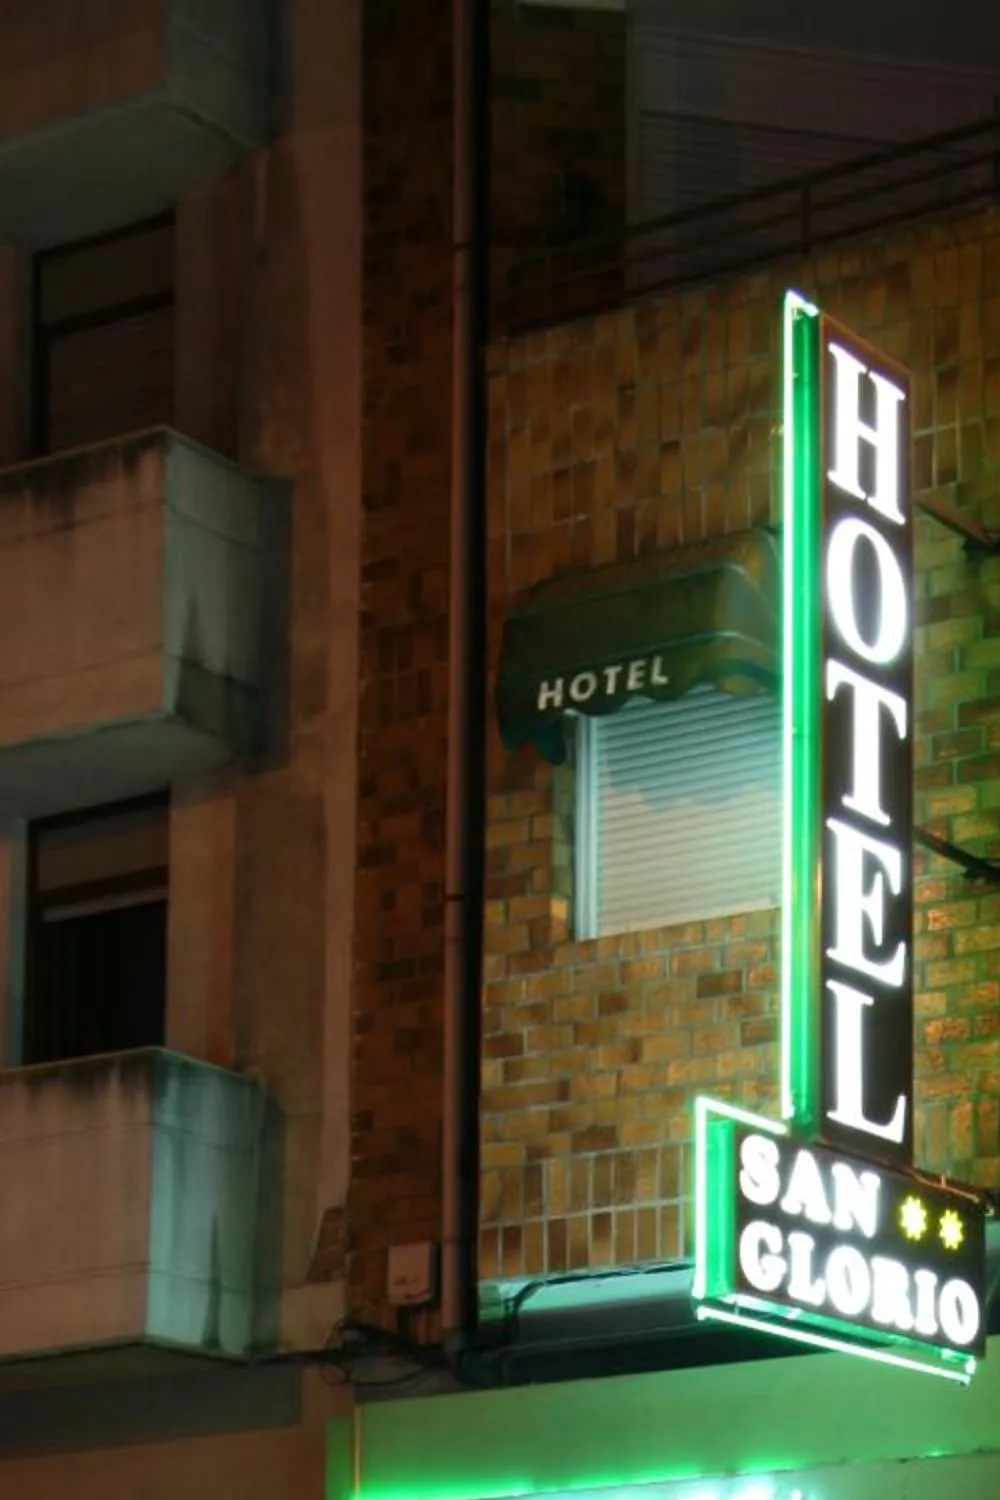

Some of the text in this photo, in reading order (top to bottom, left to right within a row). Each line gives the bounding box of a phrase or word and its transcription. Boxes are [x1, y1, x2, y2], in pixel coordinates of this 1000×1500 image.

[537, 655, 669, 711] HOTEL
[826, 341, 907, 1144] HOTEL
[739, 1134, 881, 1238] SAN
[739, 1220, 980, 1345] GLORIO
